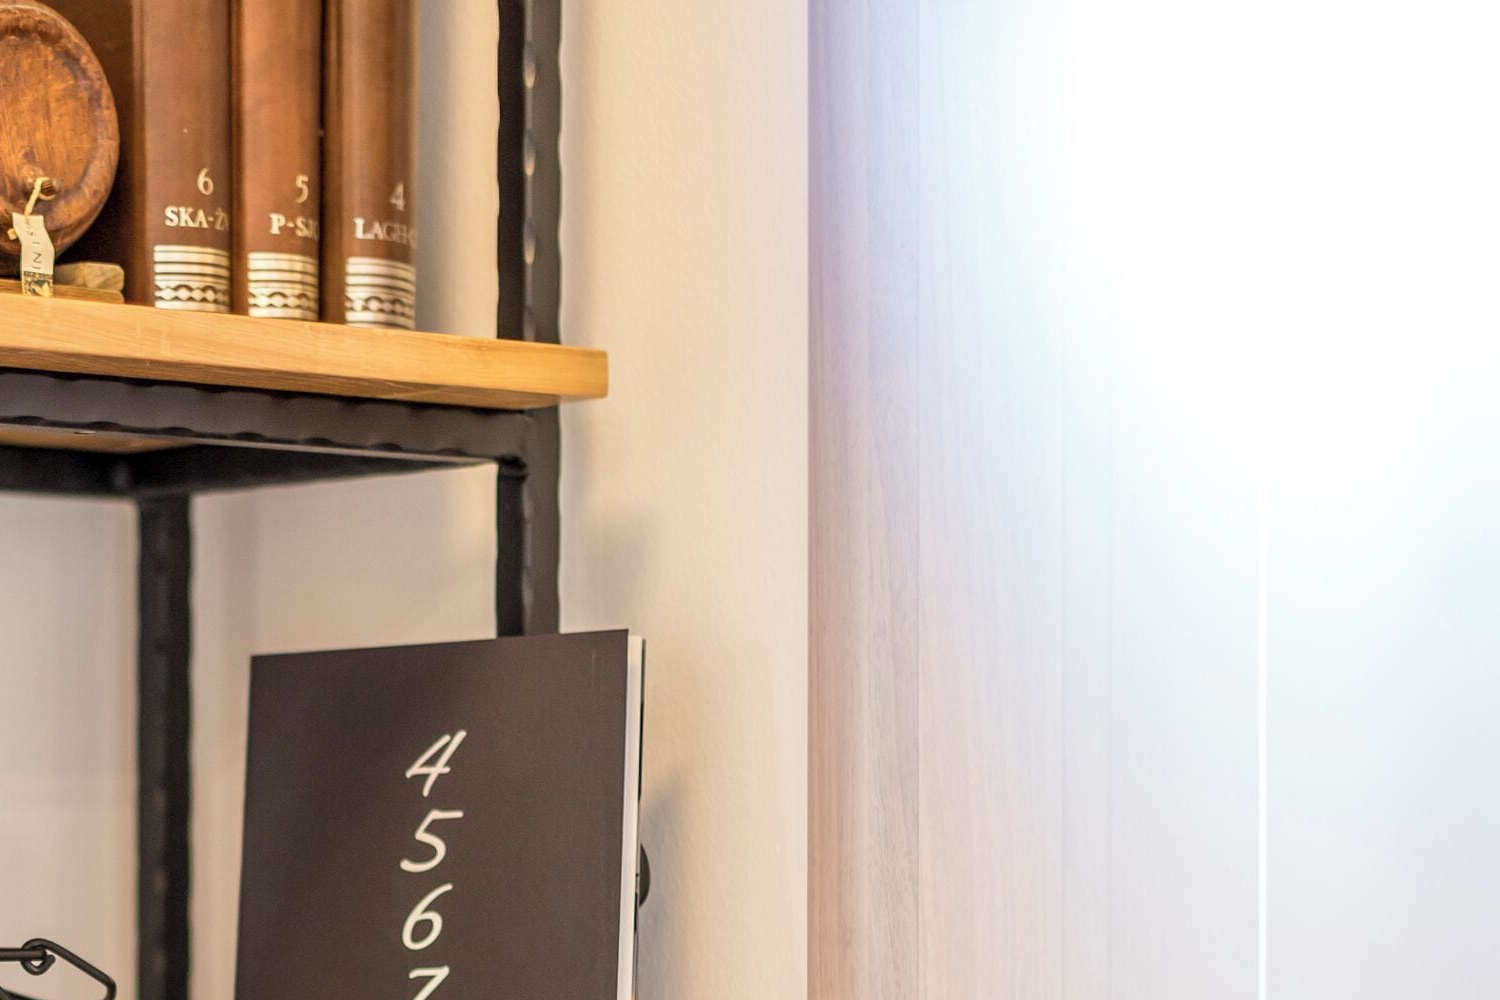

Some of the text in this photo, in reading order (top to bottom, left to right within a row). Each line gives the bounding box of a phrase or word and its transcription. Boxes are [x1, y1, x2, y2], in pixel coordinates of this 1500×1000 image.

[197, 167, 214, 196] 6
[295, 174, 309, 204] 5
[389, 182, 406, 212] 4
[404, 729, 467, 798] 4
[399, 808, 464, 873] 5
[401, 882, 454, 951] 6
